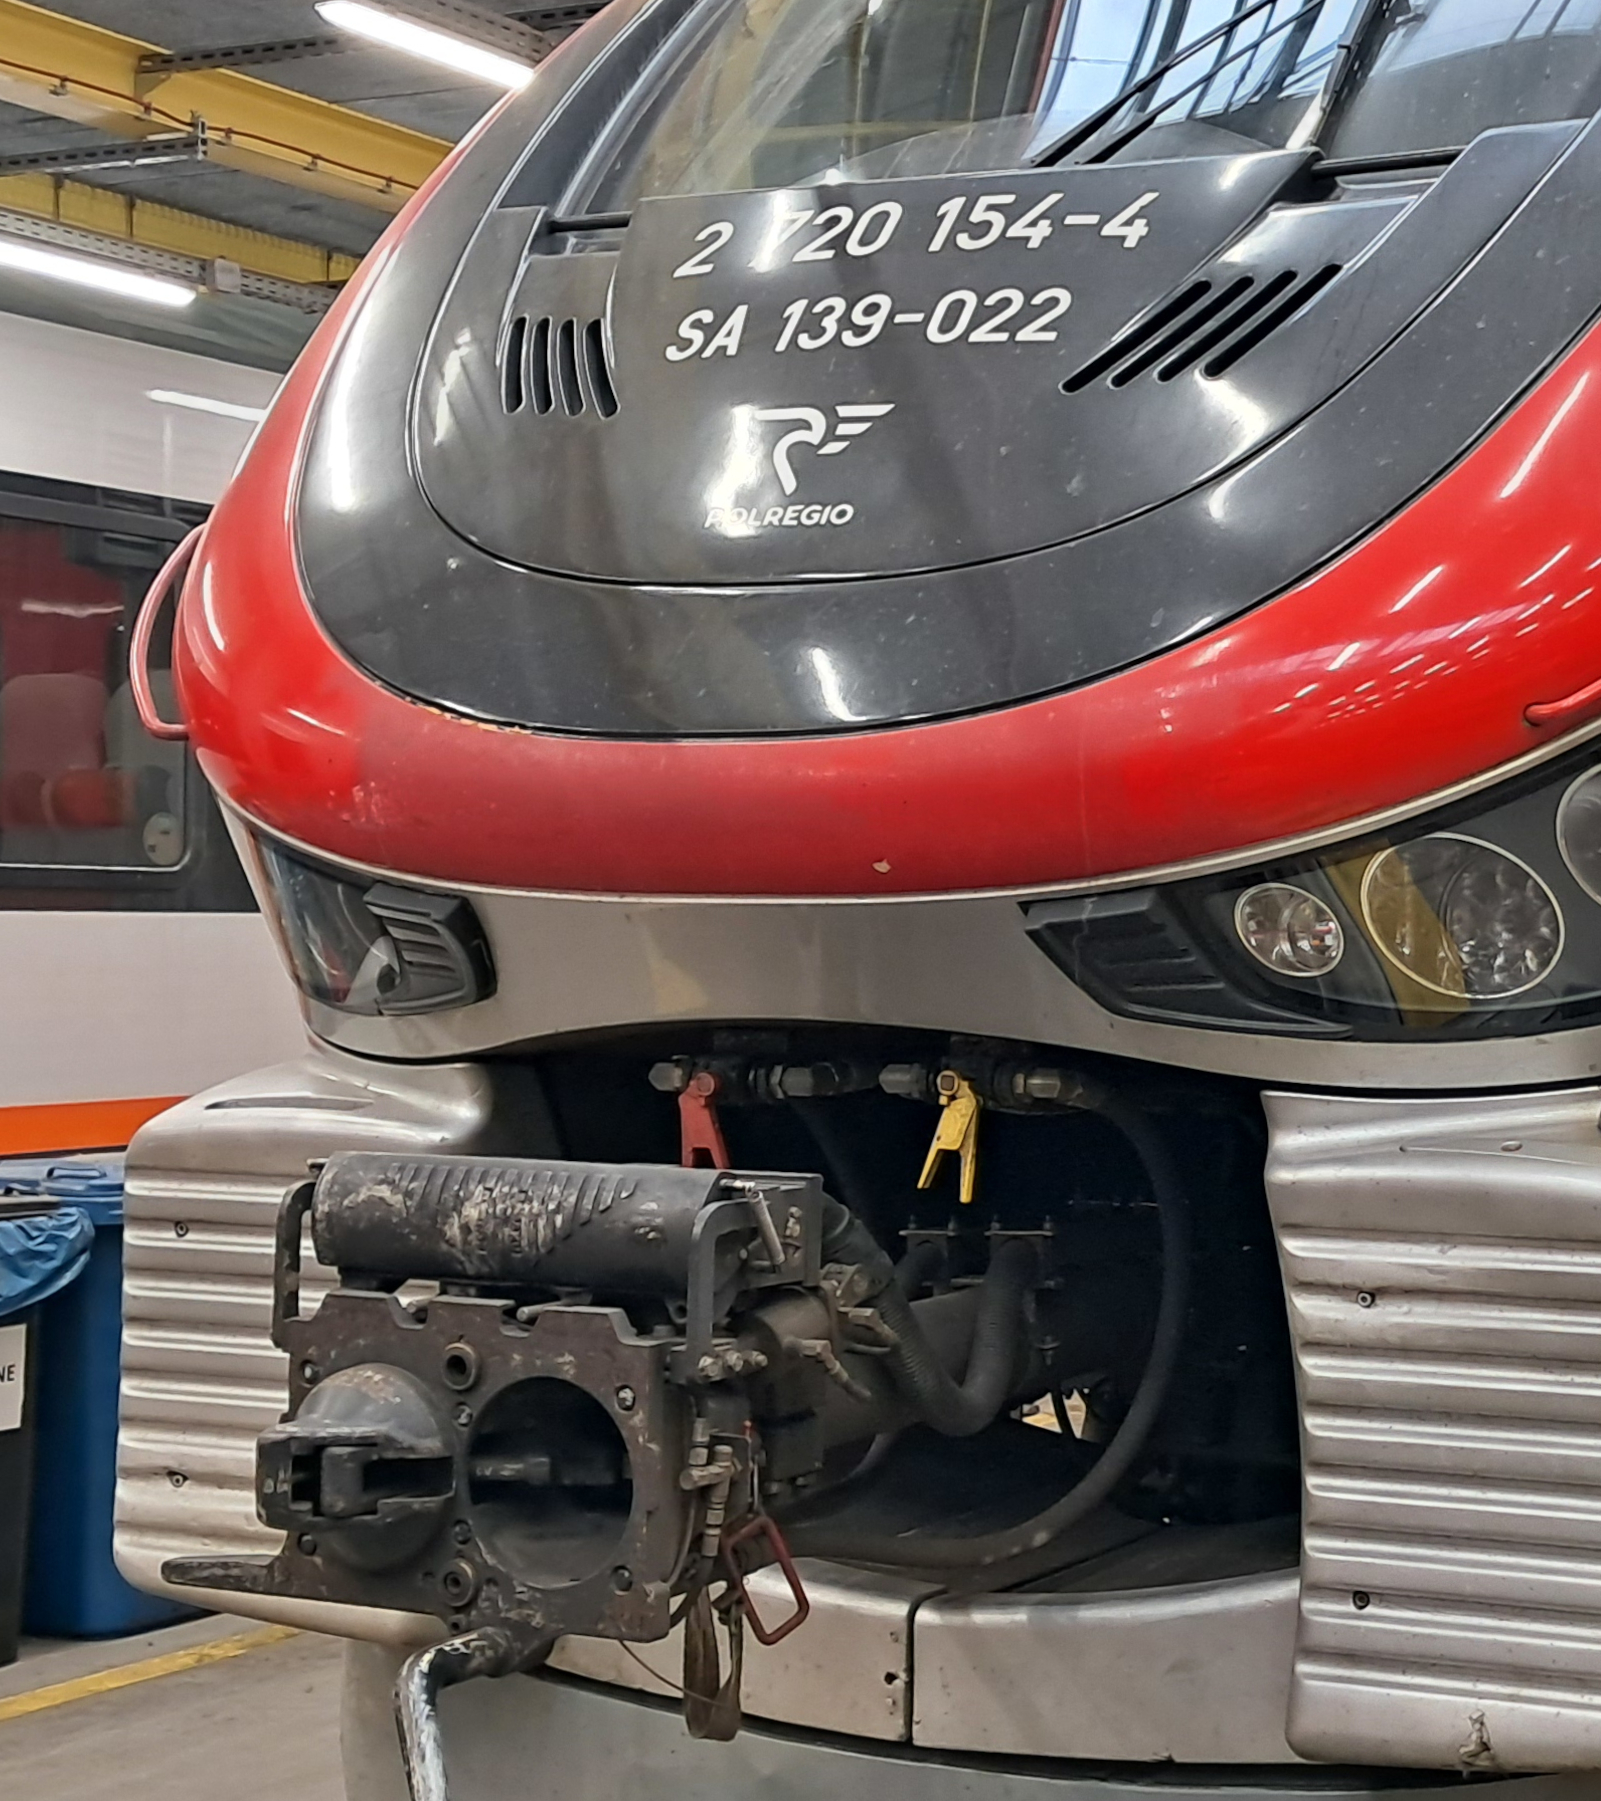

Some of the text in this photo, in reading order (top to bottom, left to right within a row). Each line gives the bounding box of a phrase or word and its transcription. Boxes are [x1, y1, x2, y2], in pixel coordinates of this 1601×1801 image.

[672, 191, 1161, 279] 2 720 154-4
[664, 286, 1073, 362] SA 139-022
[703, 503, 855, 529] POLREGIO
